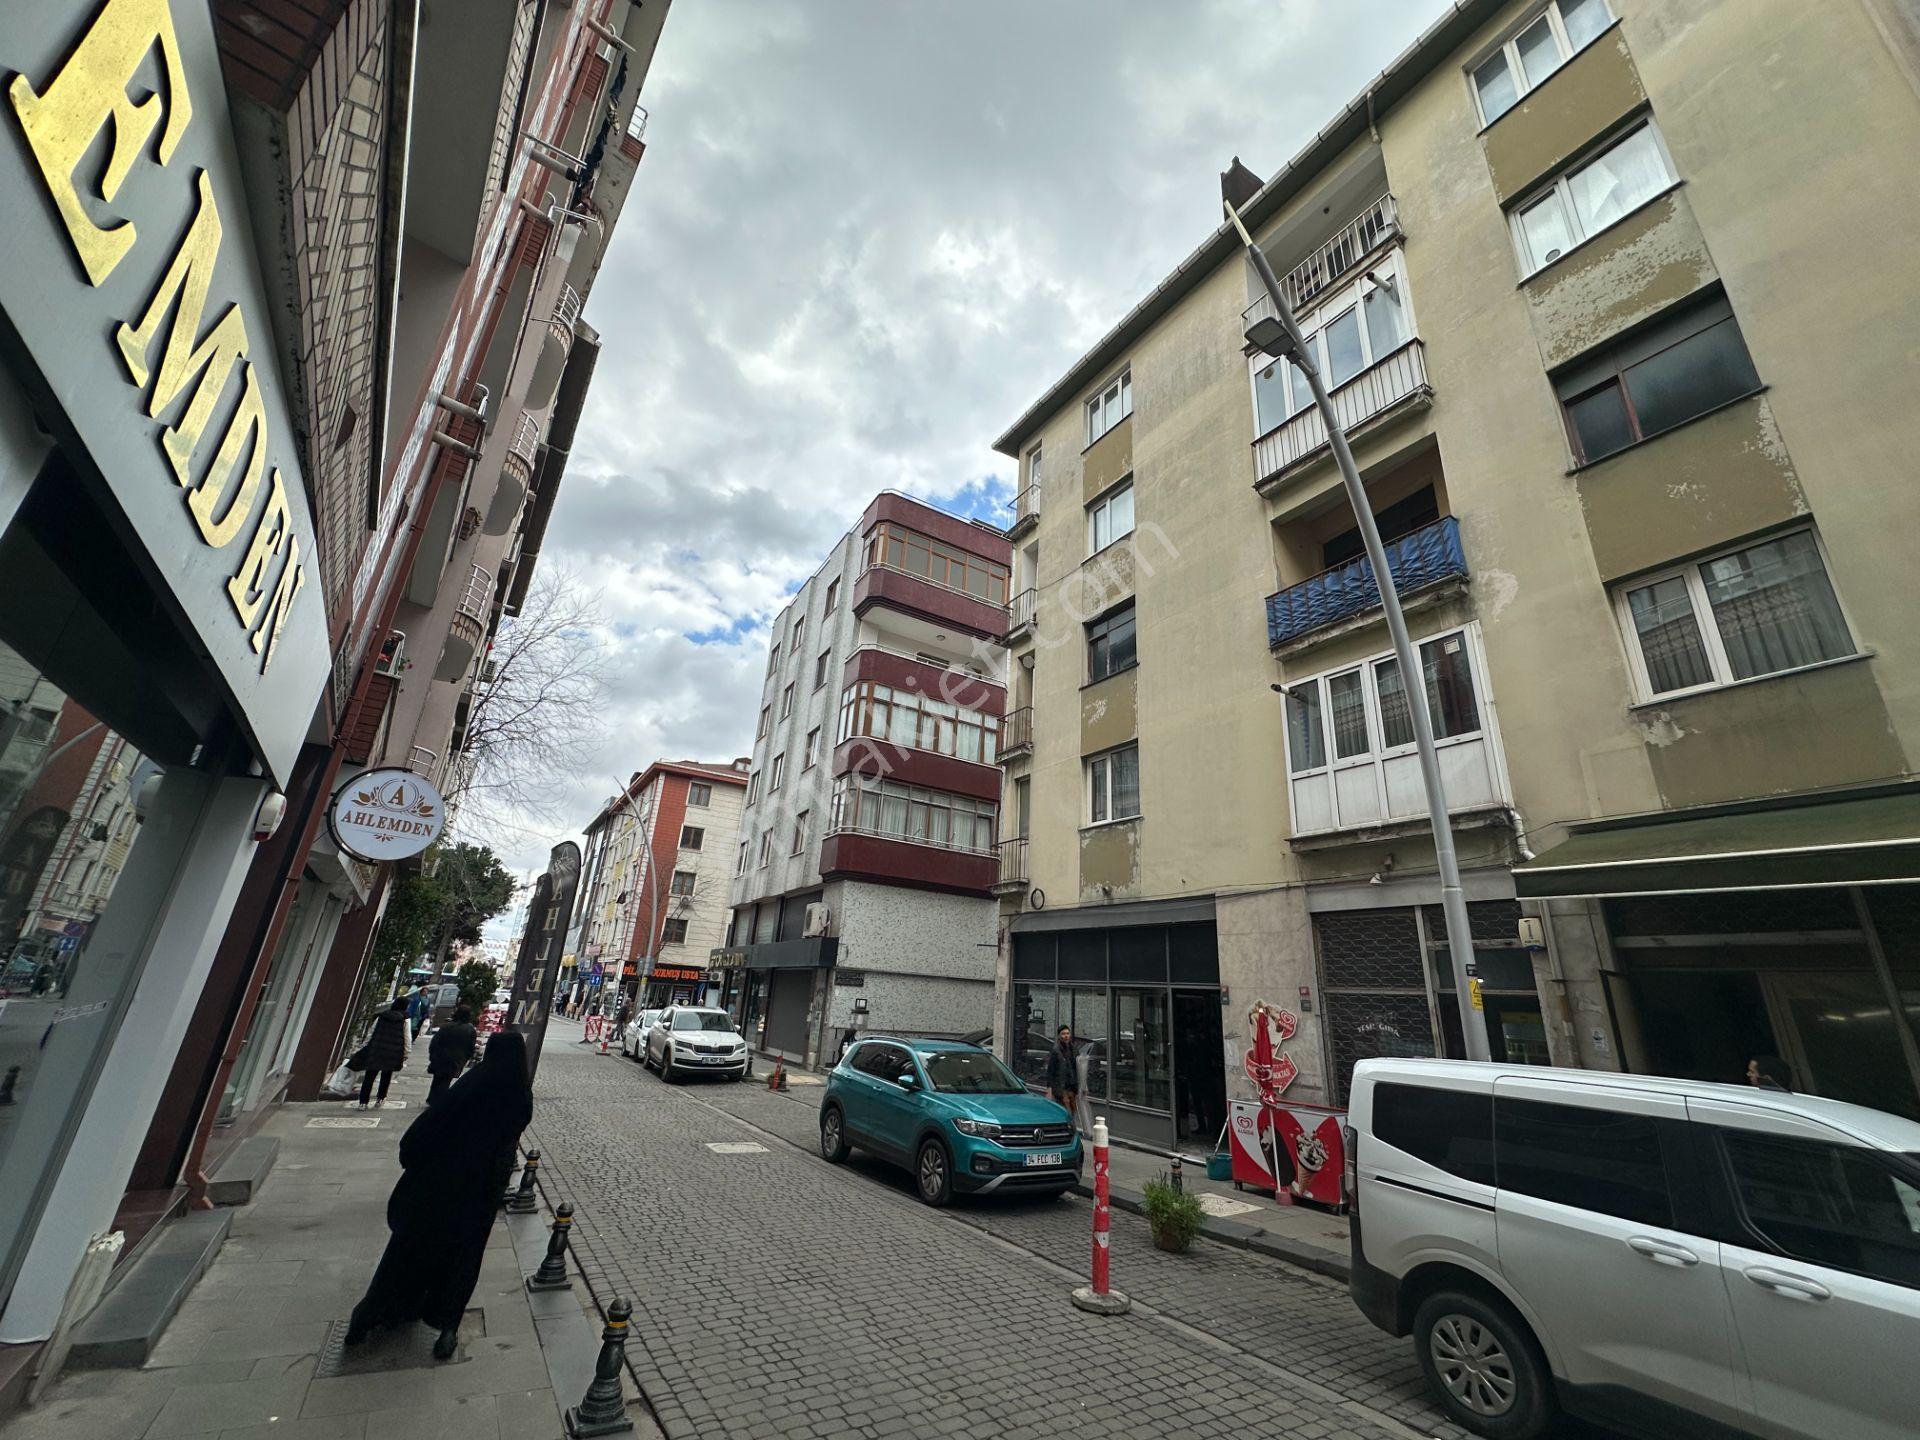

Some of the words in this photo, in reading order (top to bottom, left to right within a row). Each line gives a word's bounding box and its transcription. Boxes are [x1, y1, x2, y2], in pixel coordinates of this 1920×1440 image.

[388, 785, 405, 806] A
[341, 810, 435, 837] AHLEMDEN
[681, 969, 699, 980] USTA
[1027, 1154, 1035, 1165] 34
